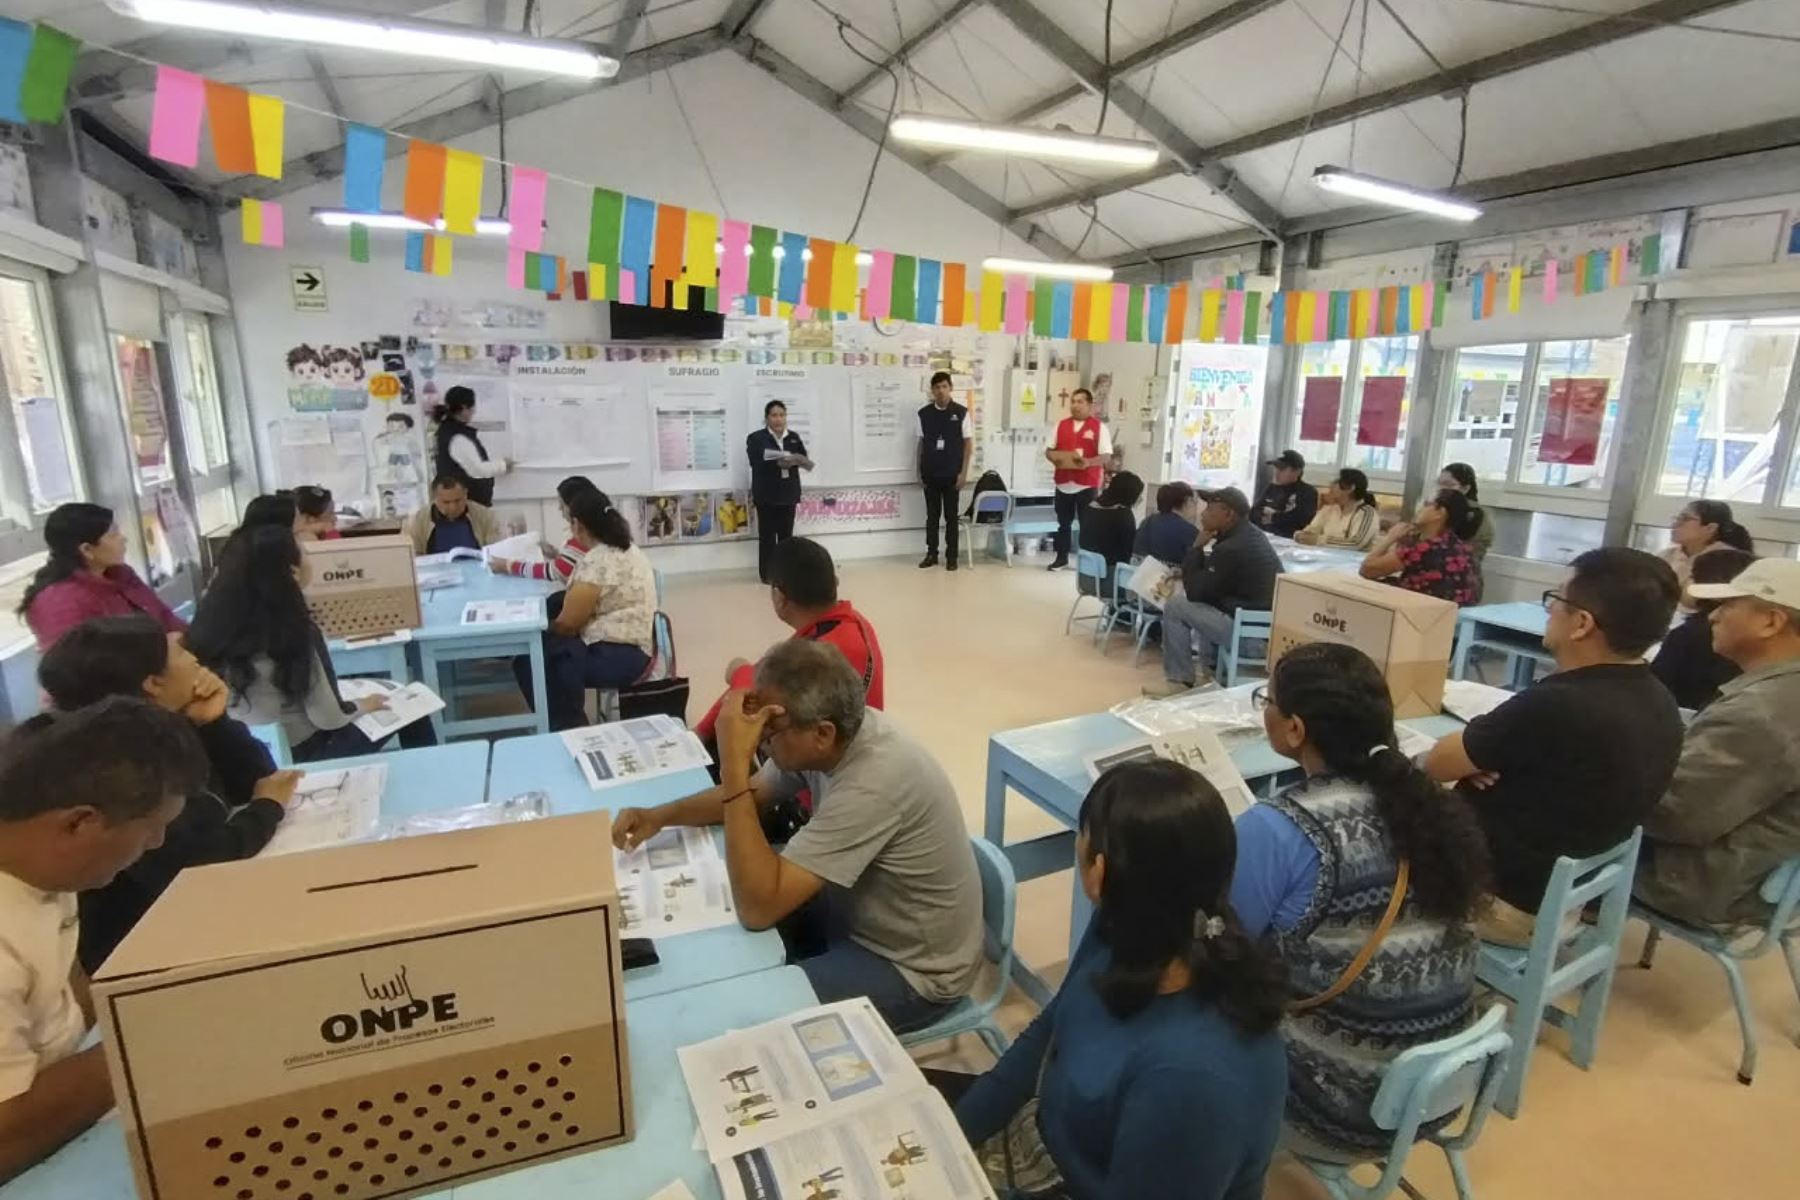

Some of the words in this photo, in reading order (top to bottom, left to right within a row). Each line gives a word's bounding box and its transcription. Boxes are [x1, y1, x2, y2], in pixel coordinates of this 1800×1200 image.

[518, 365, 586, 375] INSTALACIÓN
[668, 366, 720, 377] SUFRAGIO
[322, 568, 364, 581] ONPE
[1312, 612, 1347, 632] ONPE
[320, 992, 459, 1044] ONPE
